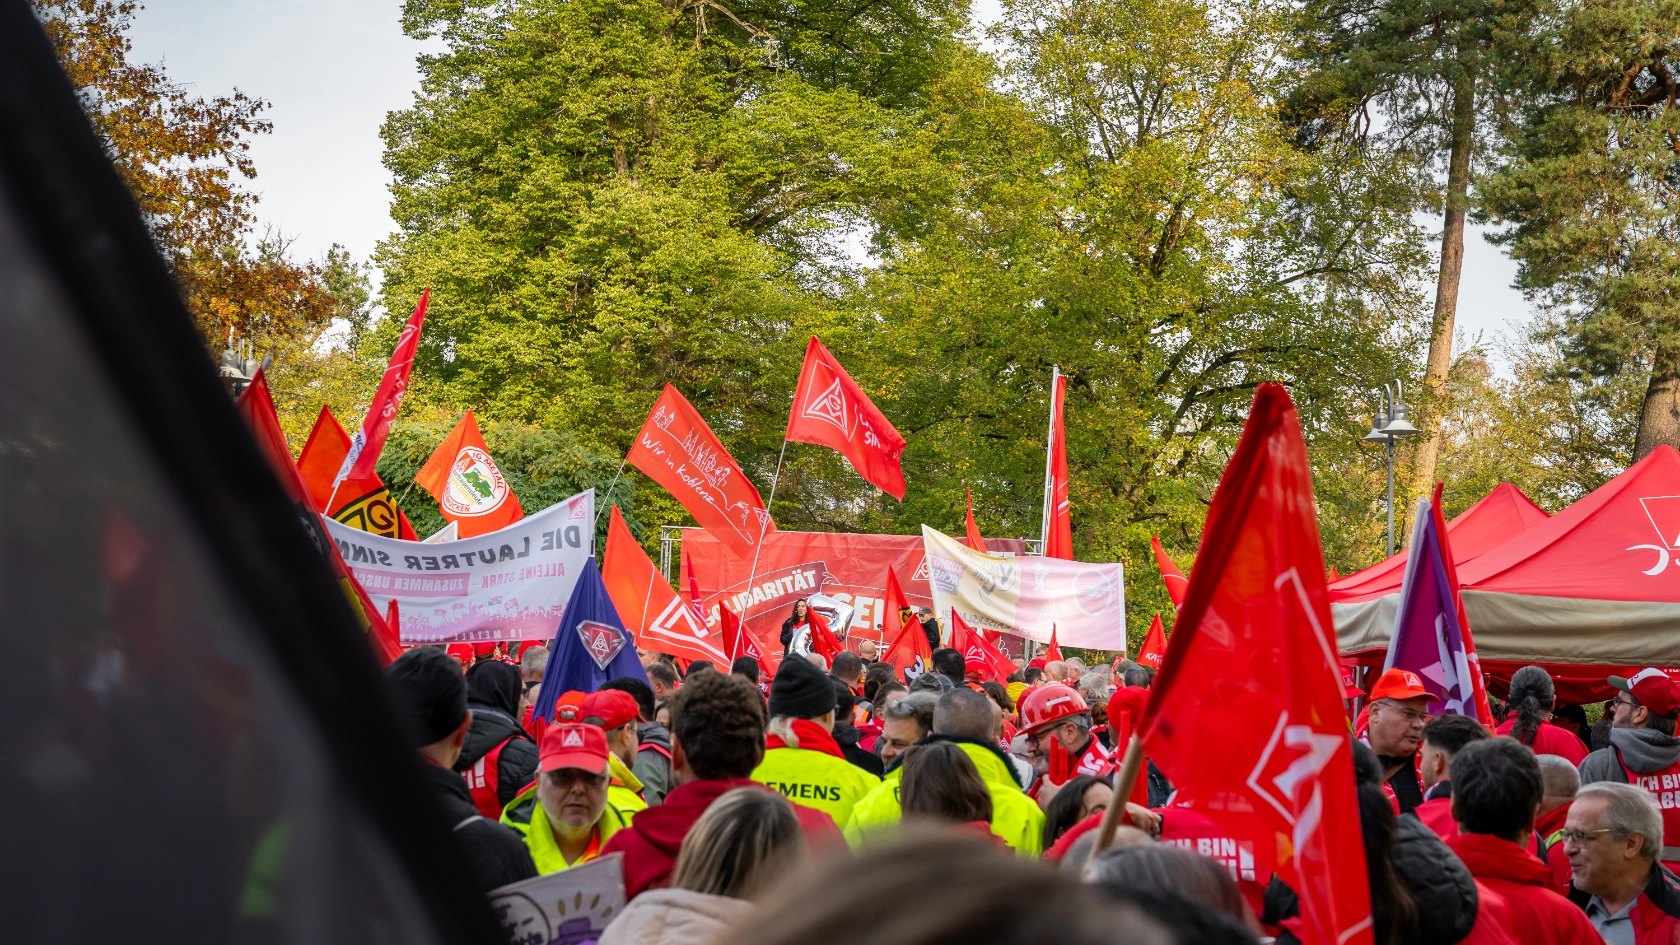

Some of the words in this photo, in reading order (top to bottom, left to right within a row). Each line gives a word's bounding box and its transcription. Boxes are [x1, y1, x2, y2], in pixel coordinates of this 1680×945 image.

[472, 451, 483, 460] IG
[483, 458, 504, 489] METALL
[642, 432, 665, 456] Wir
[665, 454, 675, 470] in
[676, 463, 715, 505] Koblenz
[705, 568, 816, 628] SOLIDARITÄT
[1636, 775, 1660, 791] ICH
[1661, 773, 1680, 790] BI
[1197, 837, 1237, 857] BIN
